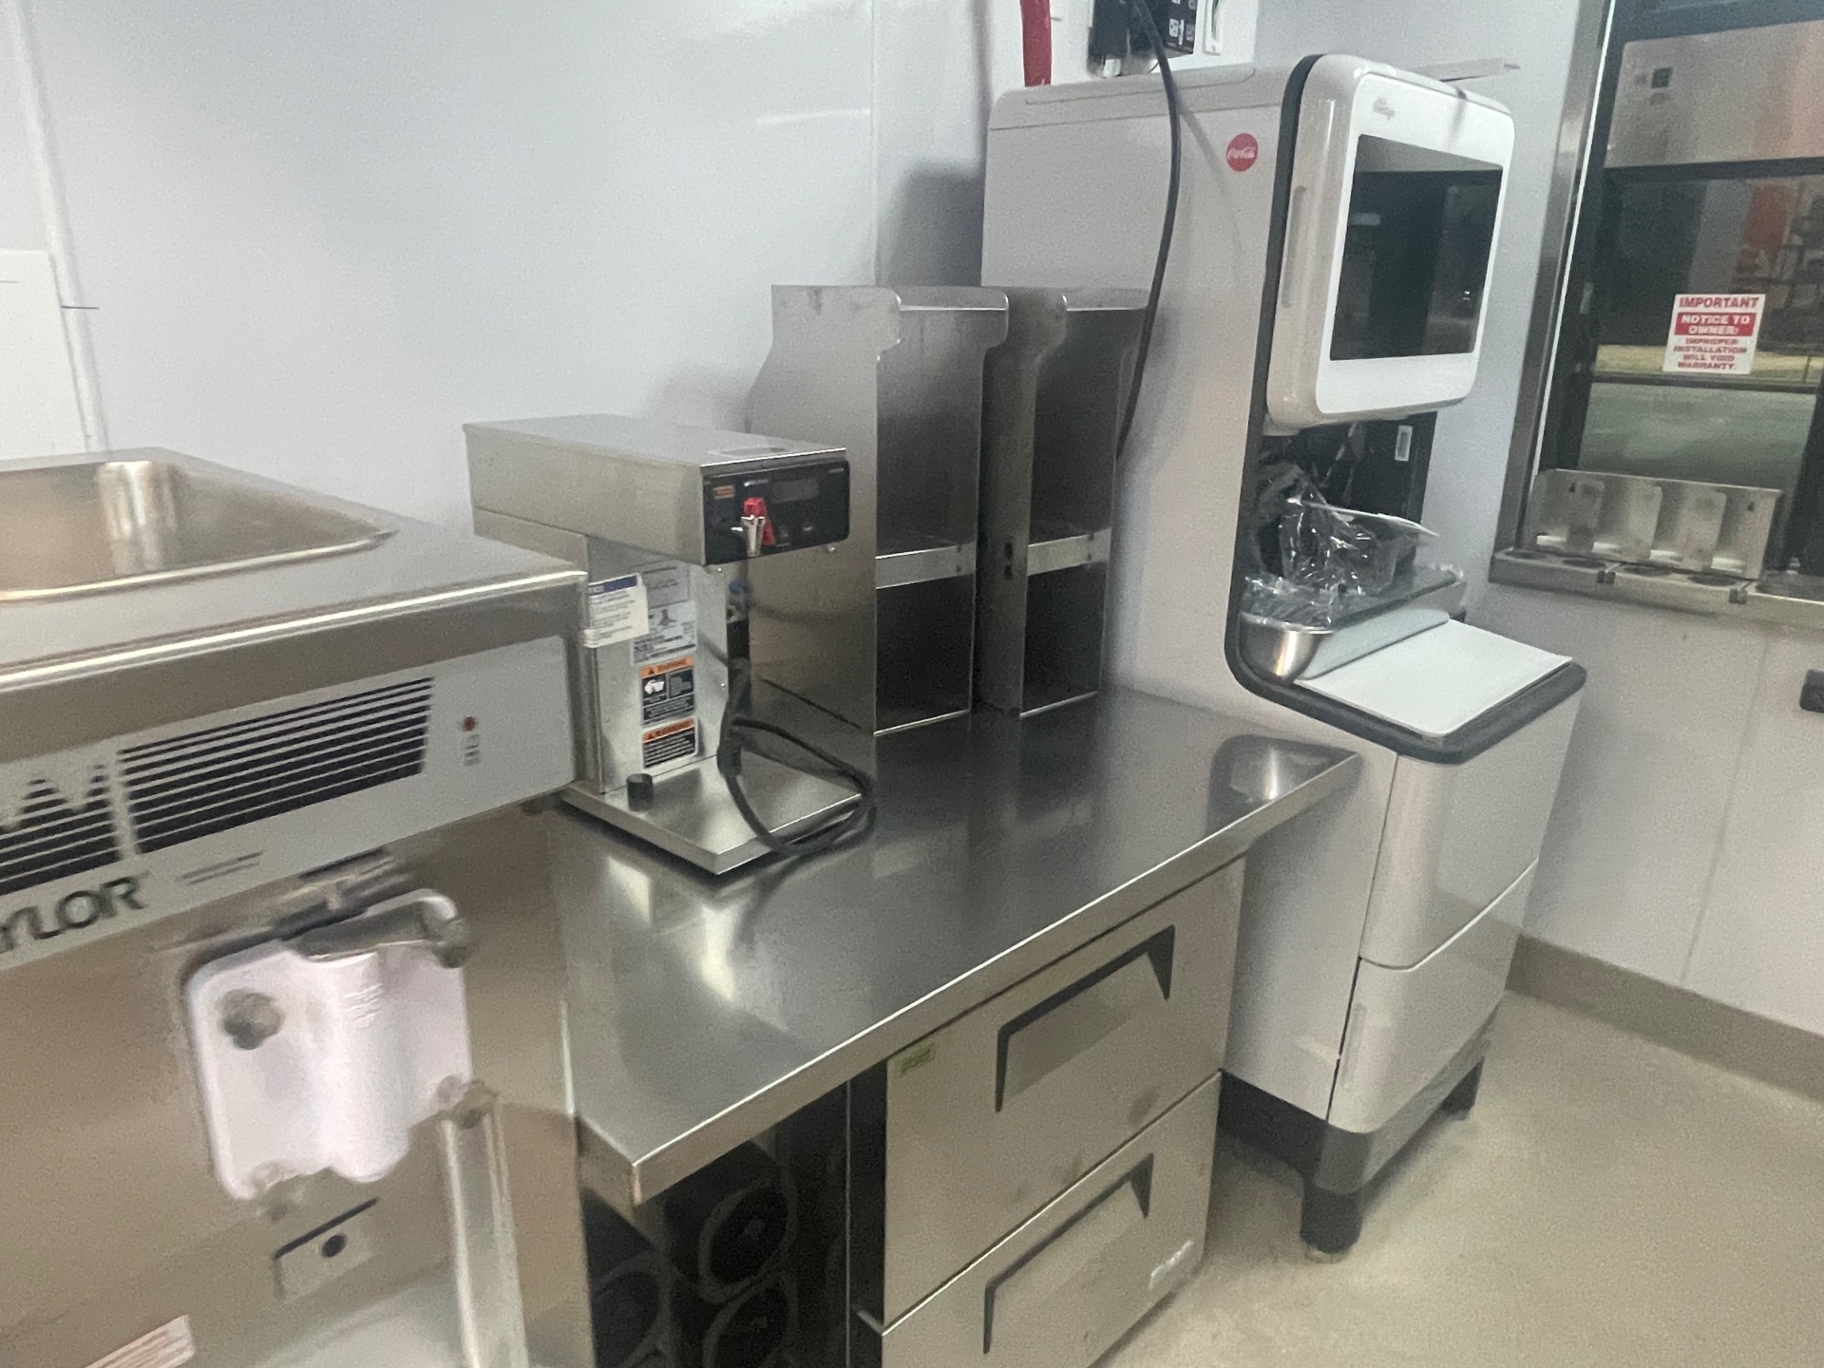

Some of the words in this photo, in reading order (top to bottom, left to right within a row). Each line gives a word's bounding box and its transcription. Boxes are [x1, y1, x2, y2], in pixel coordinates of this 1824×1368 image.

[1679, 297, 1759, 308] IMPORTANT
[1681, 315, 1728, 324] NOTICE
[1733, 315, 1750, 324] TO
[1673, 345, 1747, 353] INSTALLATION
